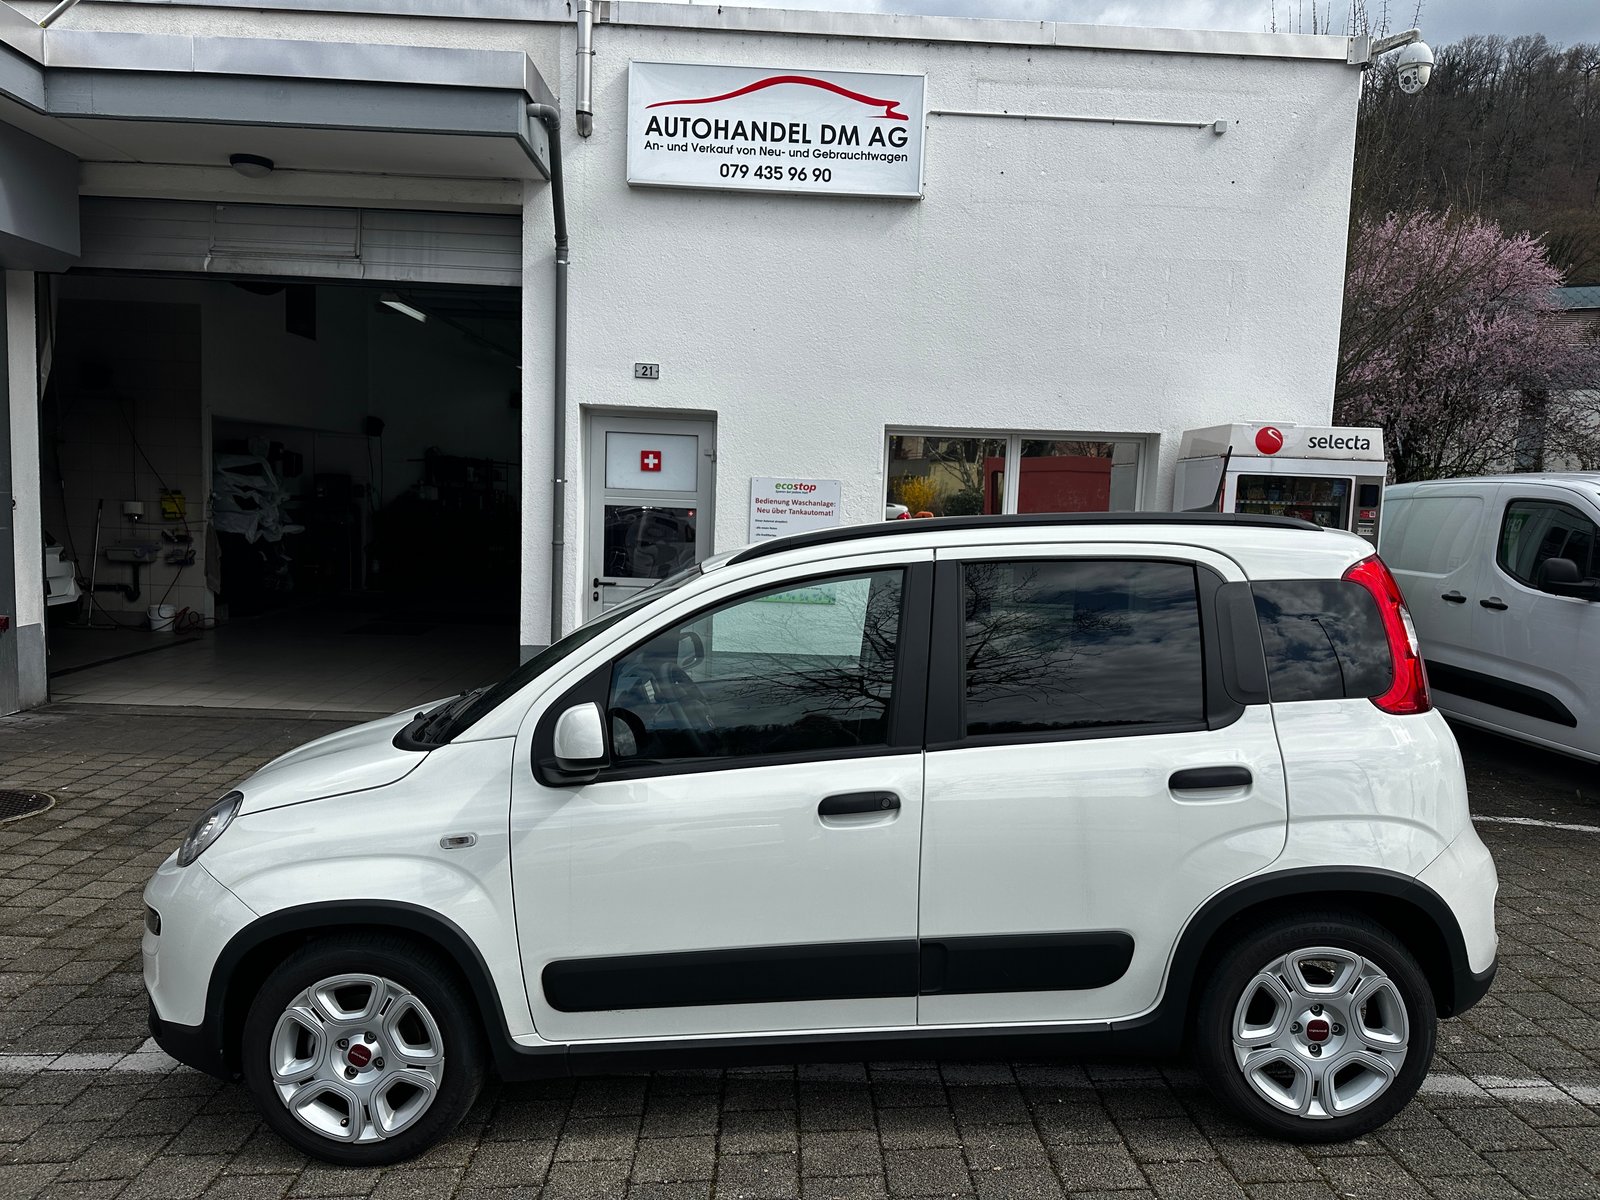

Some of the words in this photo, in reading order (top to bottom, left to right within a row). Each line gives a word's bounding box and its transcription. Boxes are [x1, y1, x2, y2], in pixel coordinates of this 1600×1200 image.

[645, 116, 811, 143] AUTOHANDEL
[821, 124, 859, 146] DM
[868, 127, 908, 148] AG
[644, 140, 663, 150] An-
[667, 143, 687, 152] und
[691, 143, 733, 154] Verkauf
[760, 147, 785, 156] Neu-
[789, 149, 809, 158] und
[813, 149, 907, 163] Gebrauchtwagen
[720, 164, 749, 178] 079
[754, 166, 783, 180] 435
[788, 167, 807, 181] 96
[813, 168, 831, 182] 90
[642, 366, 653, 376] 21
[1308, 435, 1370, 450] selecta
[775, 482, 817, 492] ecostop
[755, 498, 790, 506] Bedienung
[791, 500, 836, 508] Waschanlage:
[789, 509, 833, 517] Tankautomat!
